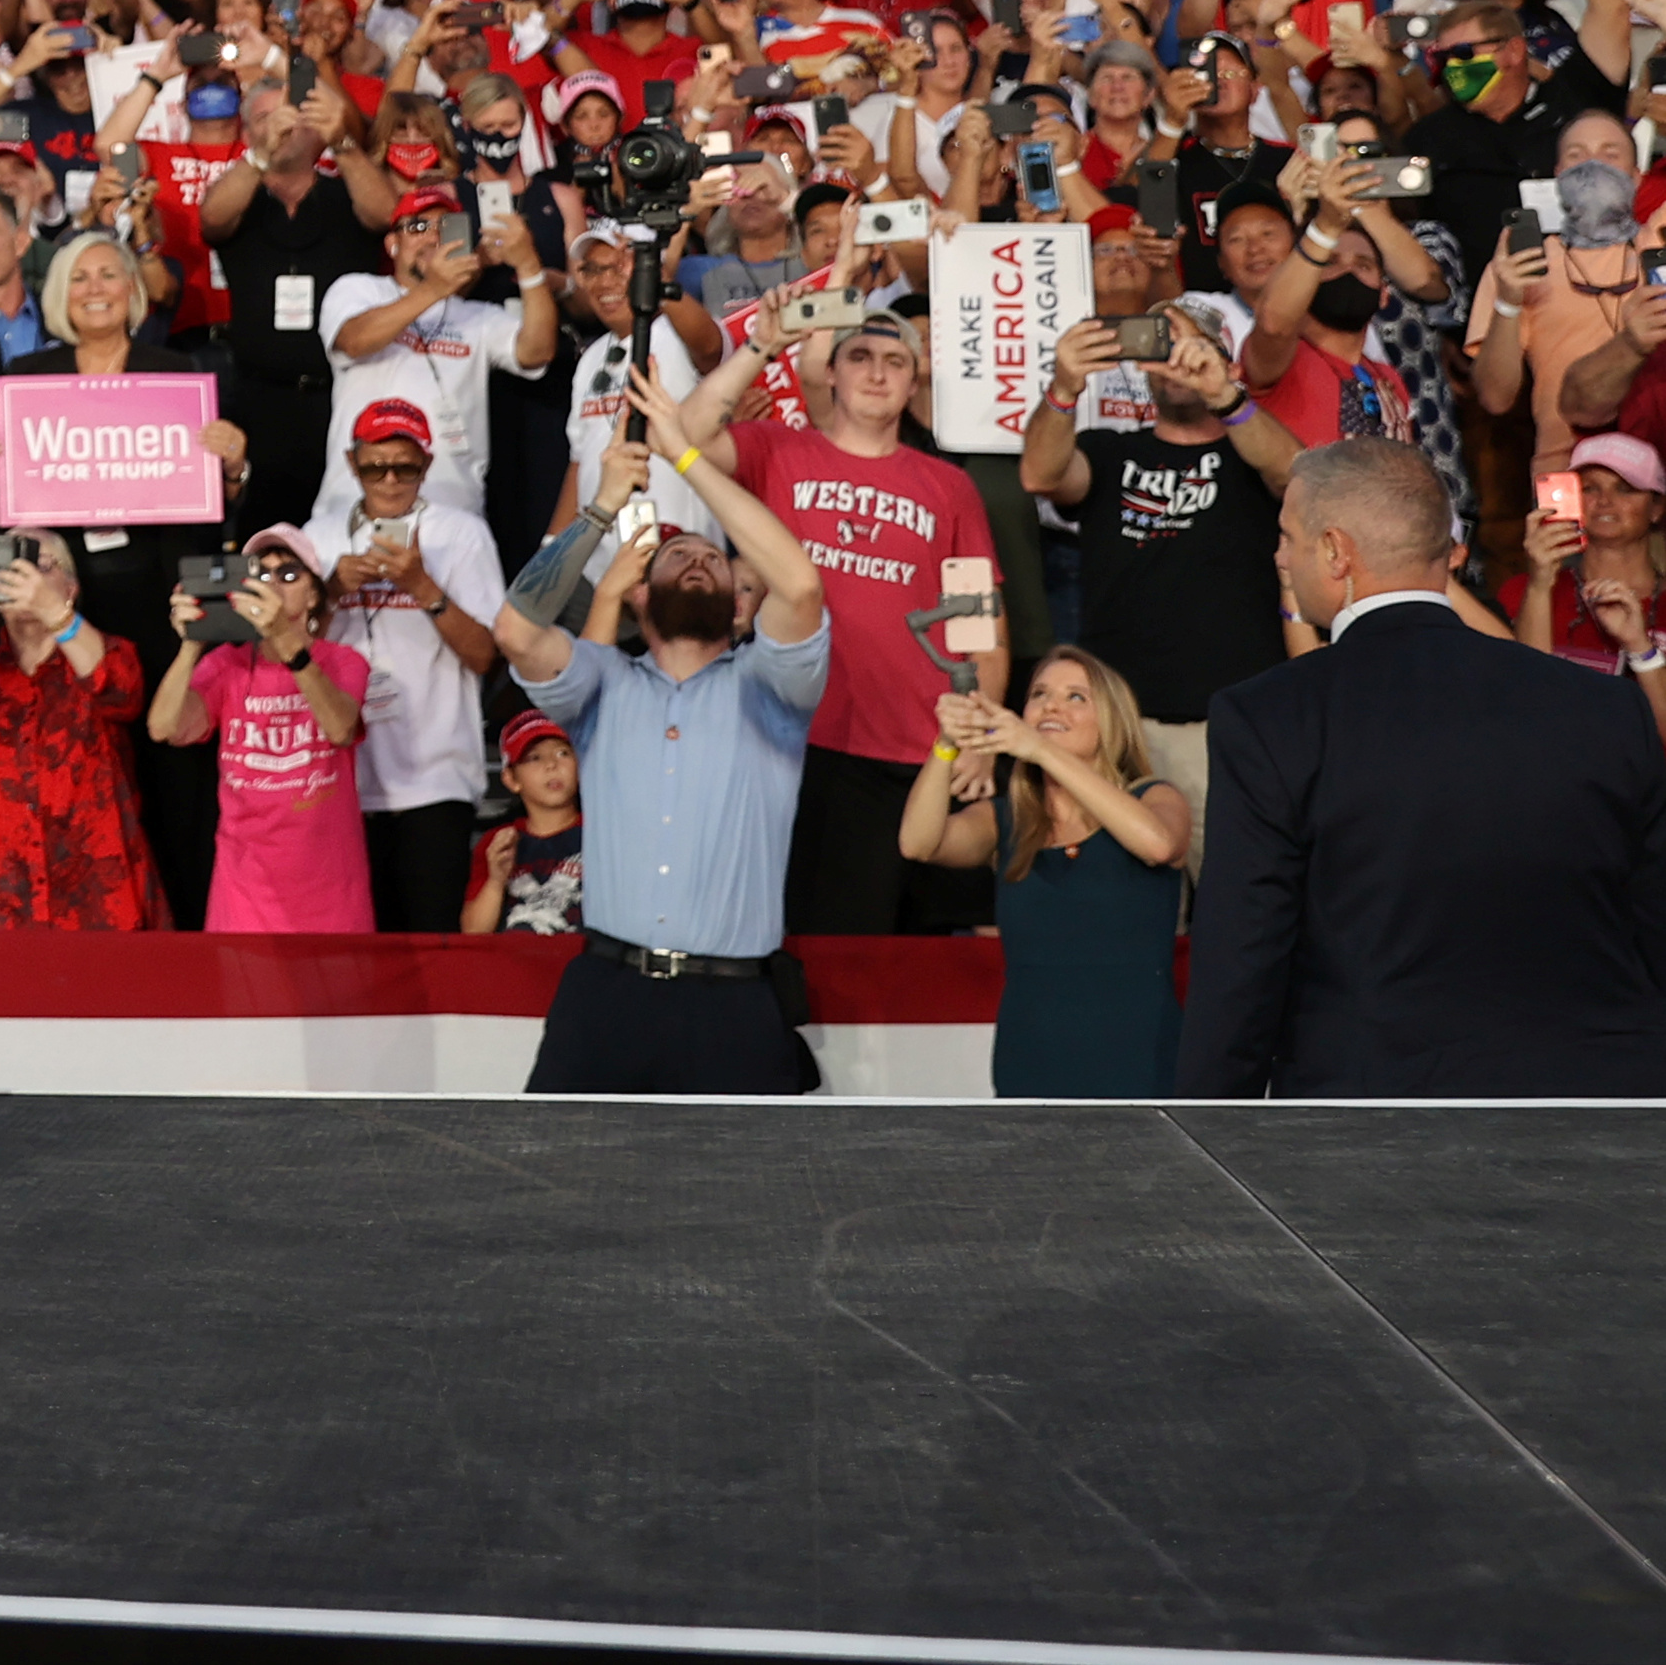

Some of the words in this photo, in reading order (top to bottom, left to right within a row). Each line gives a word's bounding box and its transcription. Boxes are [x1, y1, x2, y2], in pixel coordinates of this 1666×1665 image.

[1032, 236, 1060, 333] AGAIN
[959, 294, 983, 381] MAKE
[991, 238, 1027, 436] AMERICA
[22, 416, 191, 462] Women
[42, 463, 90, 481] FOR
[96, 461, 177, 482] TRUMP
[793, 479, 936, 543] WESTERN
[245, 693, 311, 715] WOME
[227, 717, 329, 754] TRUM
